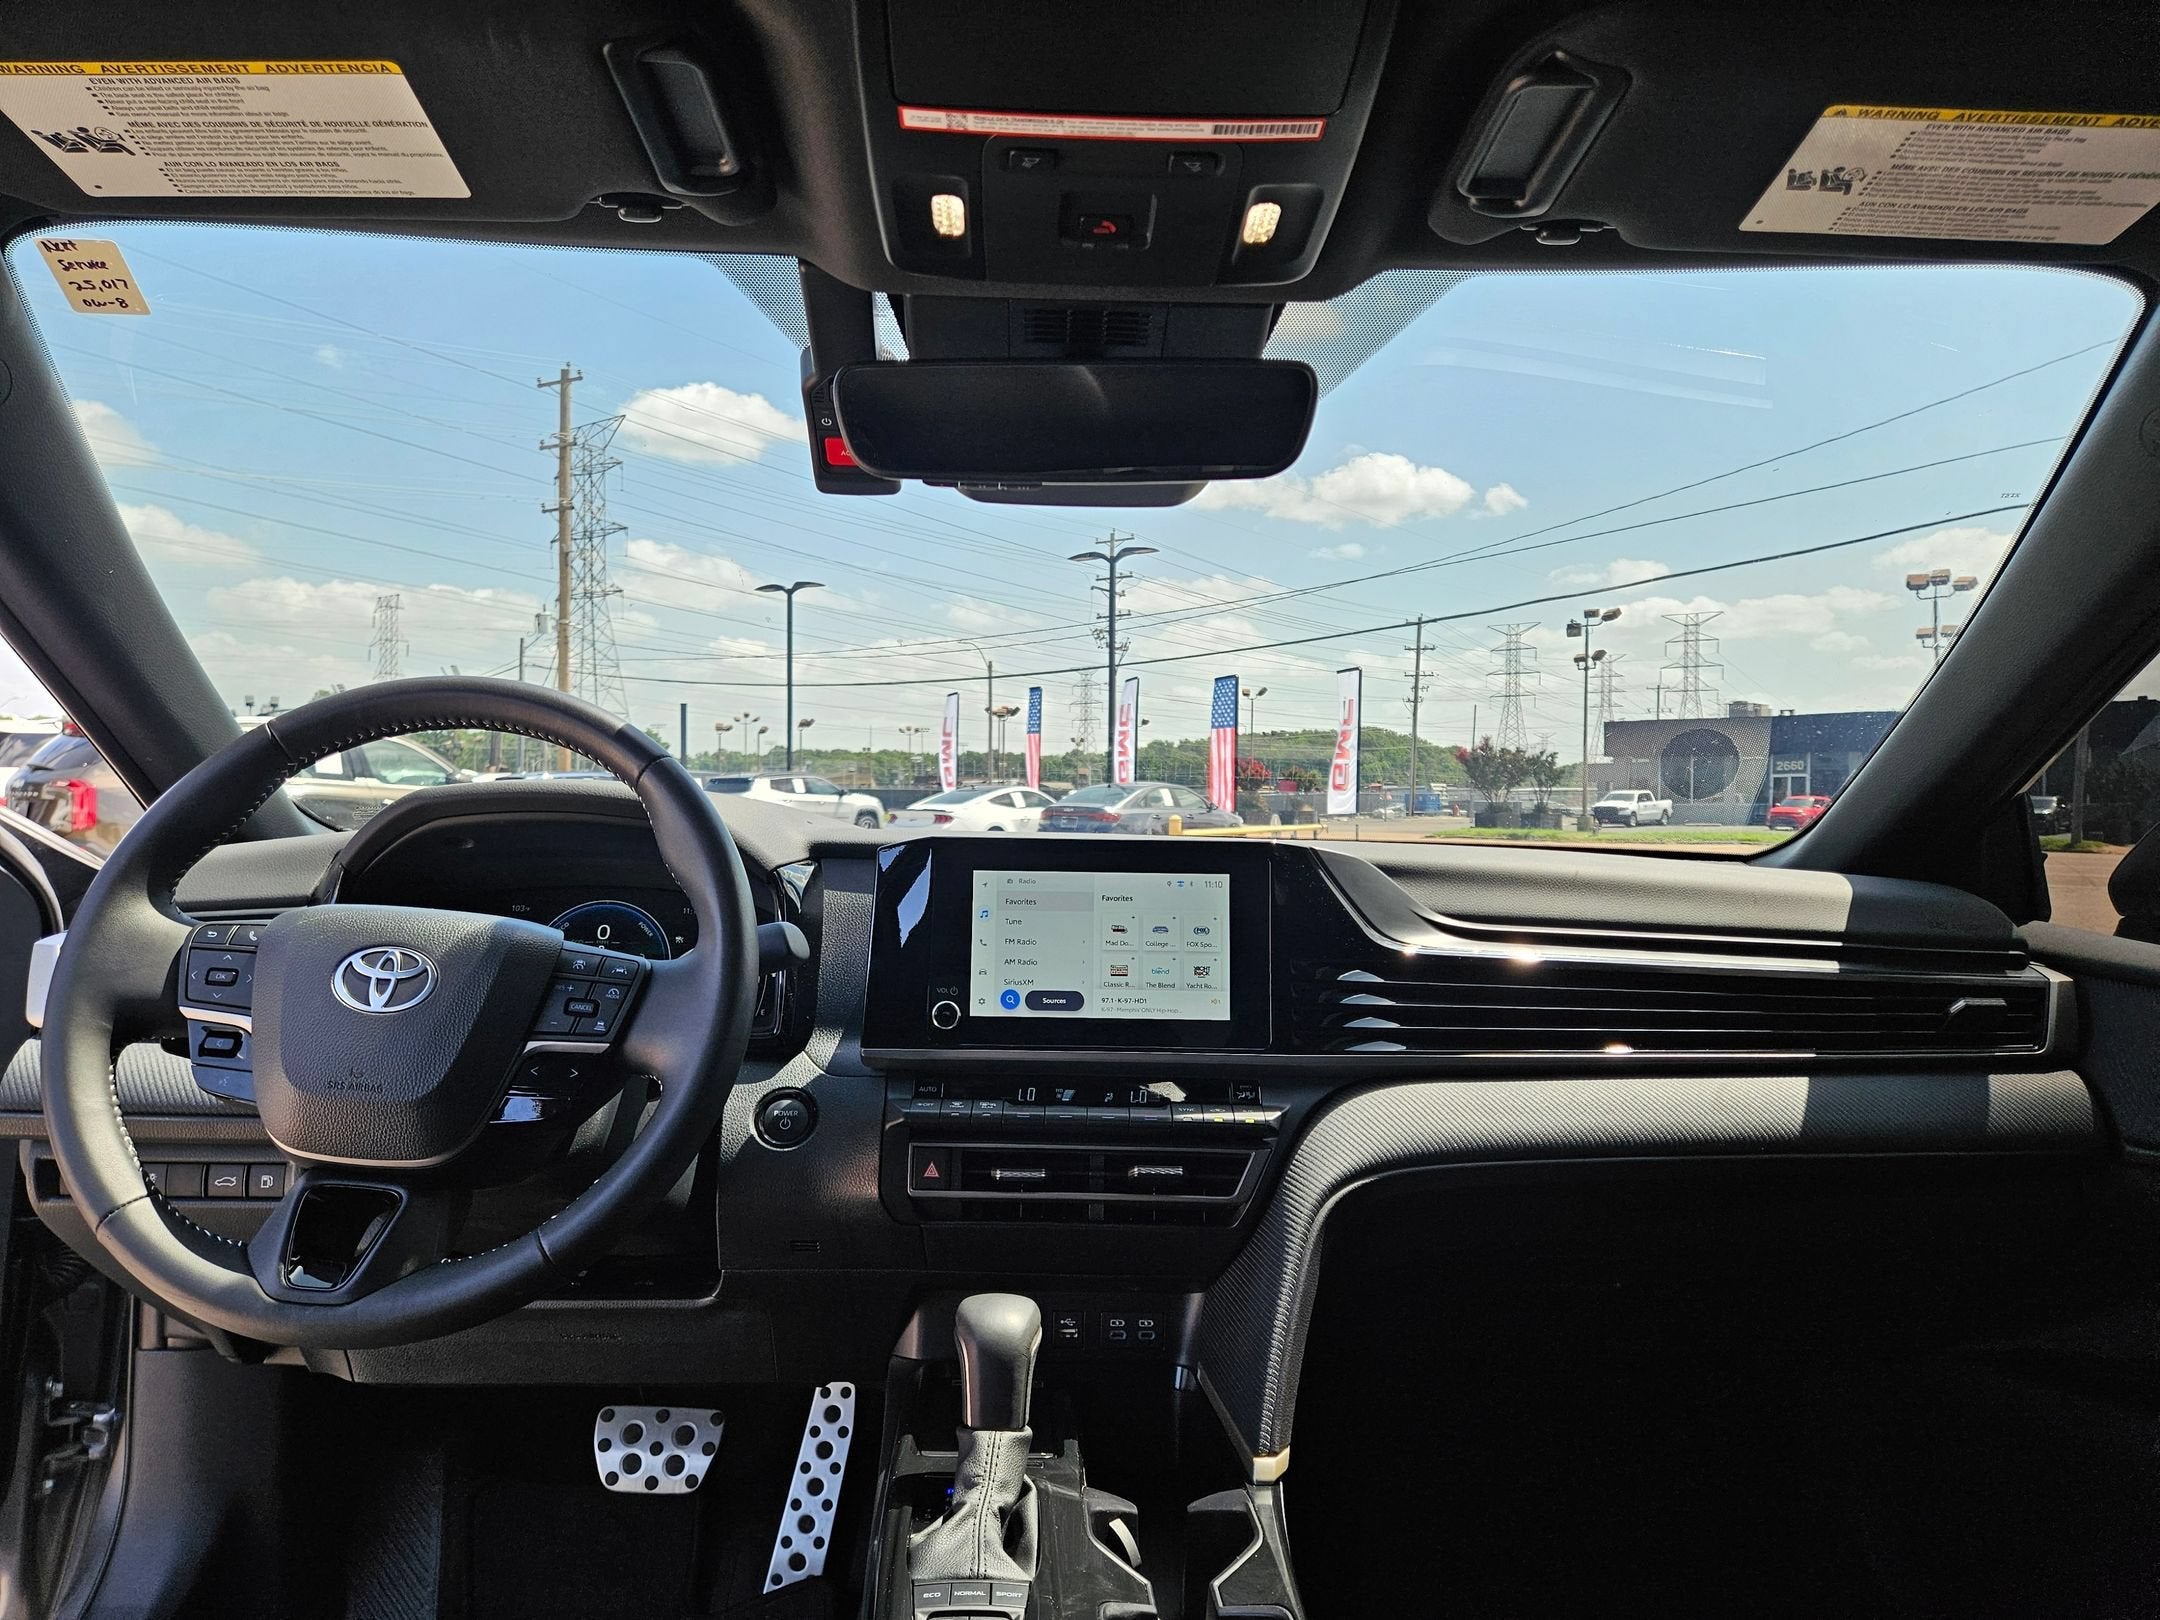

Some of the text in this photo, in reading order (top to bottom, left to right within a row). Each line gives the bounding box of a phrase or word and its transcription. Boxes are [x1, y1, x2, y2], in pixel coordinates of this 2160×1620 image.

[0, 63, 391, 74] WARNING AVERTISSEMENT ADVERTENCIA
[1858, 108, 1940, 120] WARNING
[202, 120, 248, 128] COUSSINS
[1204, 880, 1223, 888] 11:10
[1101, 894, 1133, 902] Favorites
[597, 924, 610, 940] 0
[1016, 938, 1037, 946] Radio
[1003, 978, 1034, 986] SiriusXM
[570, 1001, 593, 1011] CANCEL
